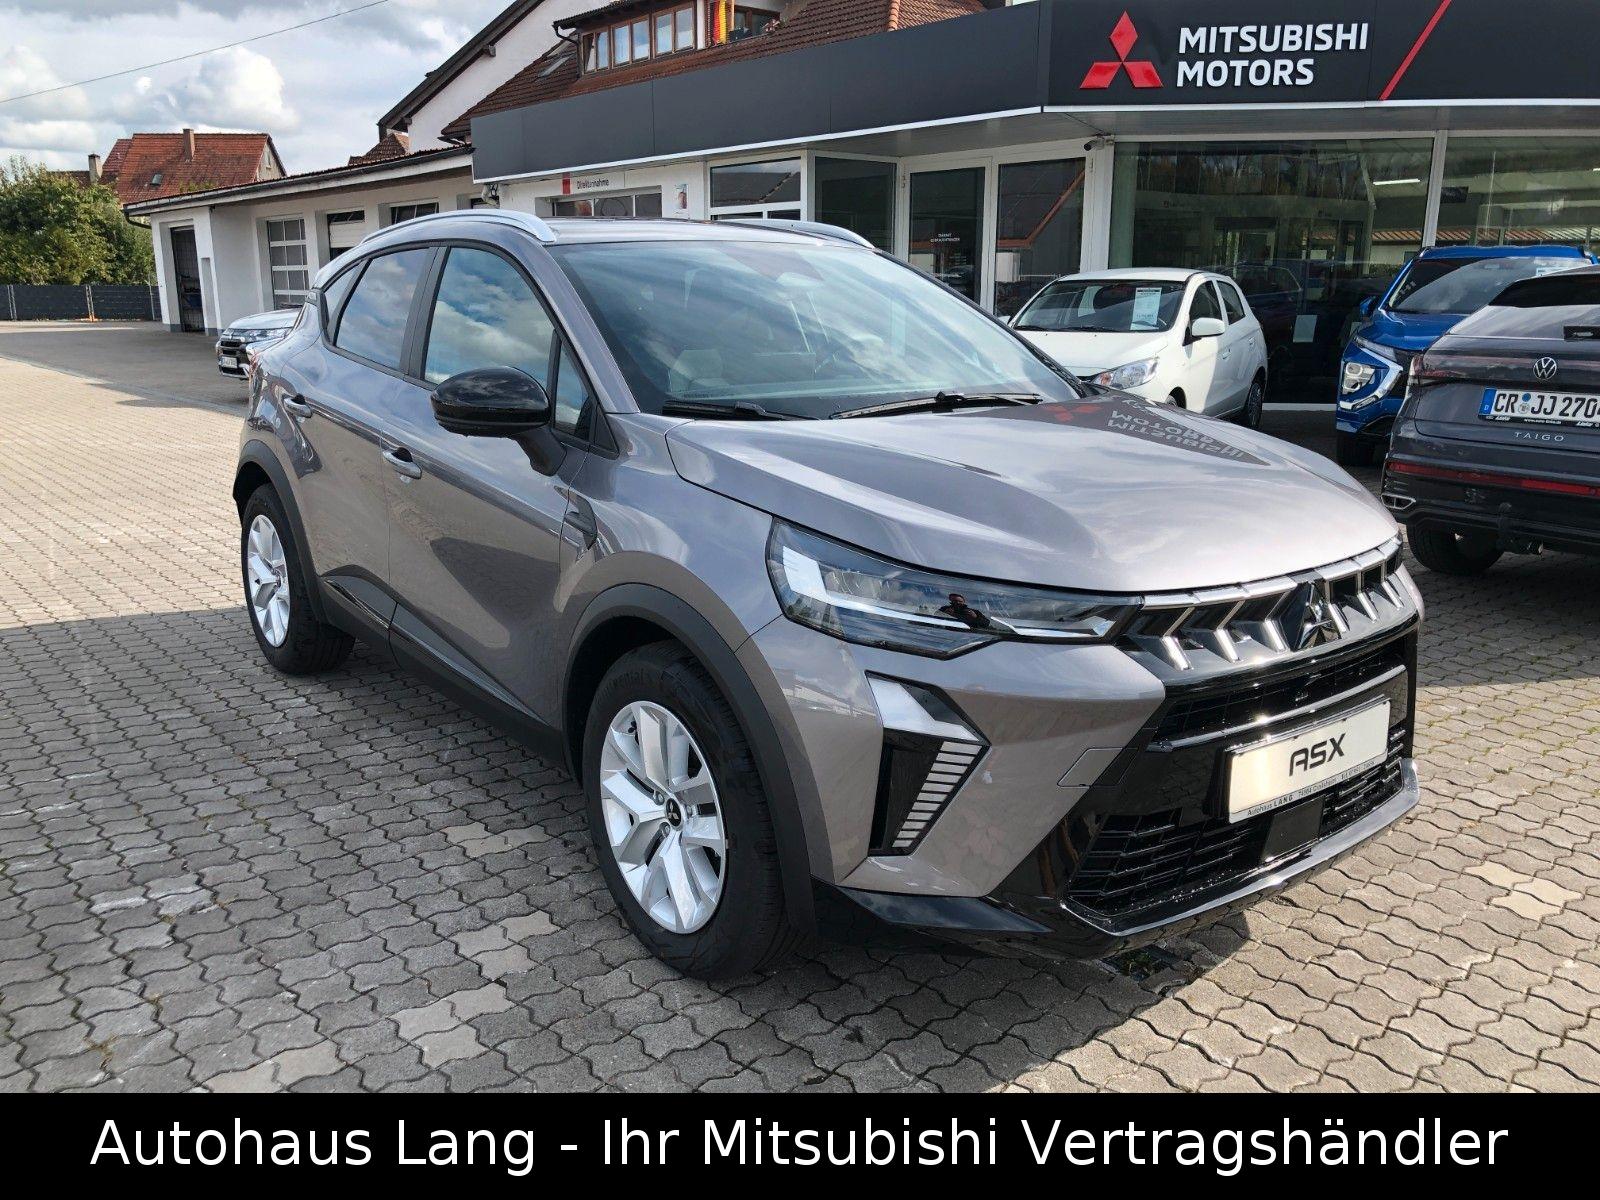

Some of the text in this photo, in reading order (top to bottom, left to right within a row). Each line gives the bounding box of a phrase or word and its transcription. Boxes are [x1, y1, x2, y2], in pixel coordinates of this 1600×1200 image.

[1178, 22, 1369, 54] MITSUBISHI
[1176, 58, 1314, 88] MOTORS
[1494, 393, 1600, 419] CR JJ 270
[1514, 431, 1564, 442] TAIGO
[1288, 732, 1347, 777] ASX
